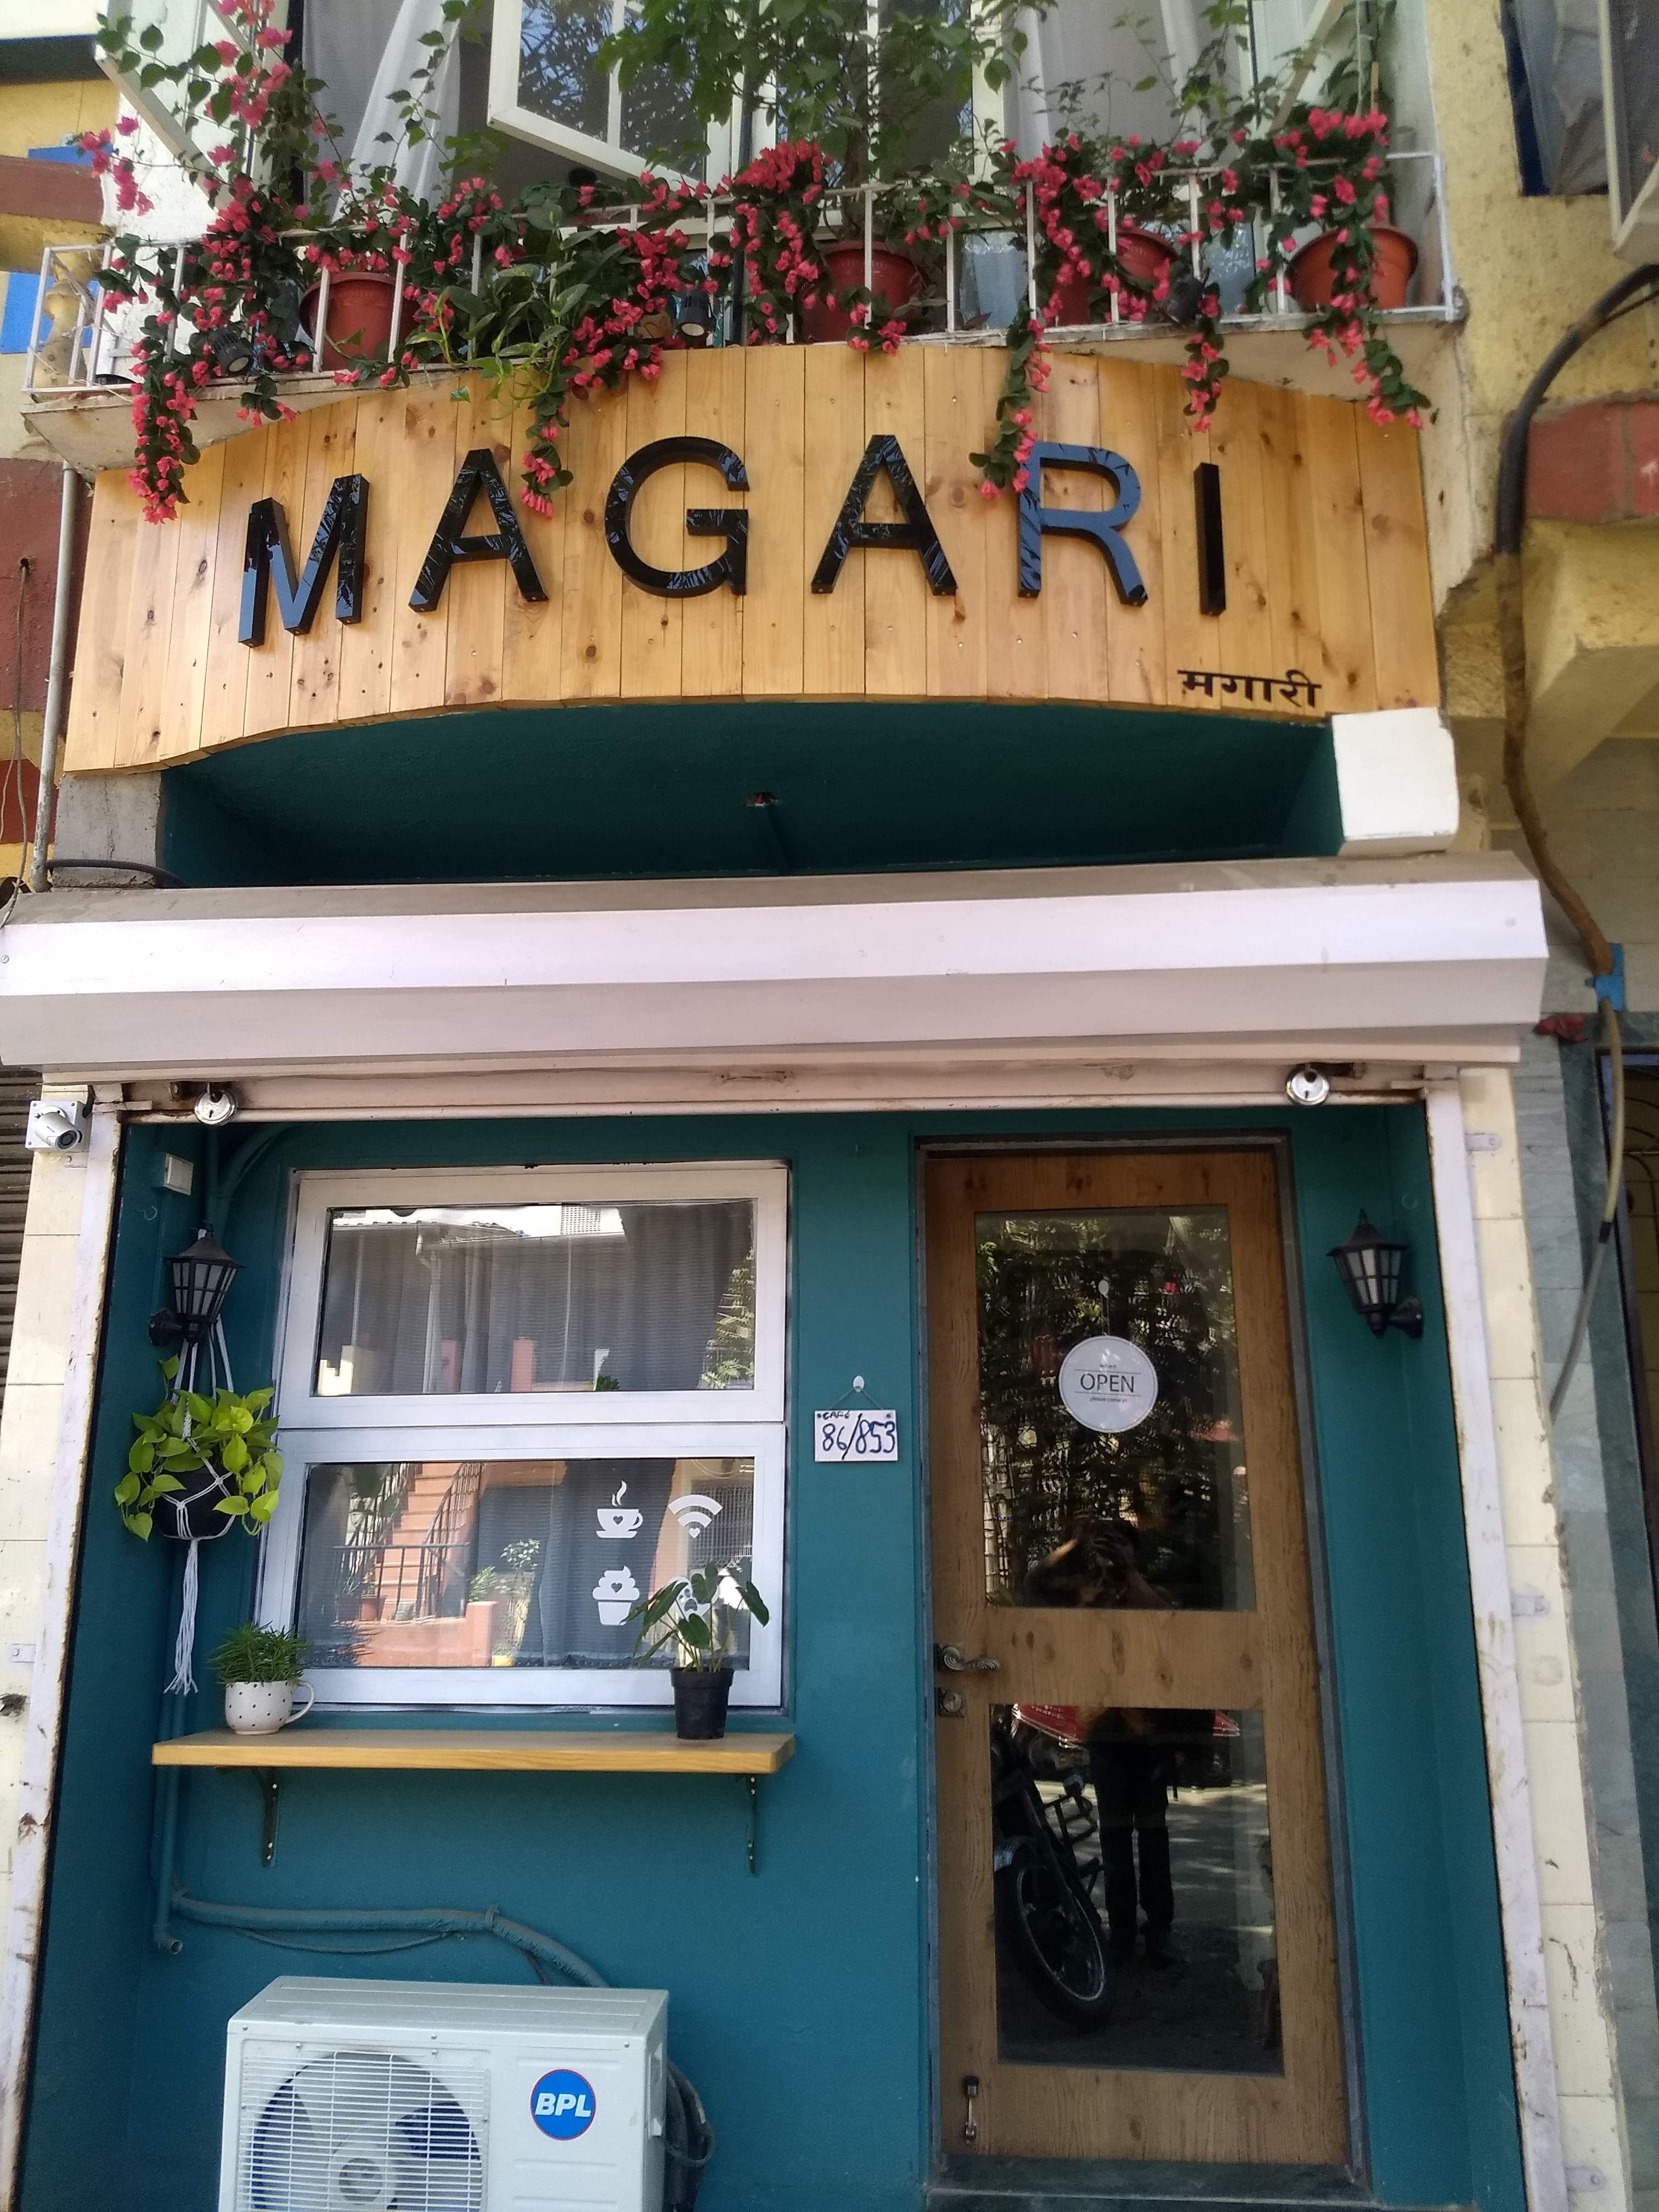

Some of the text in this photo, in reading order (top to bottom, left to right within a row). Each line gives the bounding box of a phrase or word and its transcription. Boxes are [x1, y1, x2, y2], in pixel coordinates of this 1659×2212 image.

[238, 434, 1227, 648] MAGARI
[1177, 669, 1322, 708] मगारी
[1080, 1373, 1134, 1393] OPEN
[822, 1413, 895, 1460] 86/853
[535, 2092, 591, 2118] BPL
